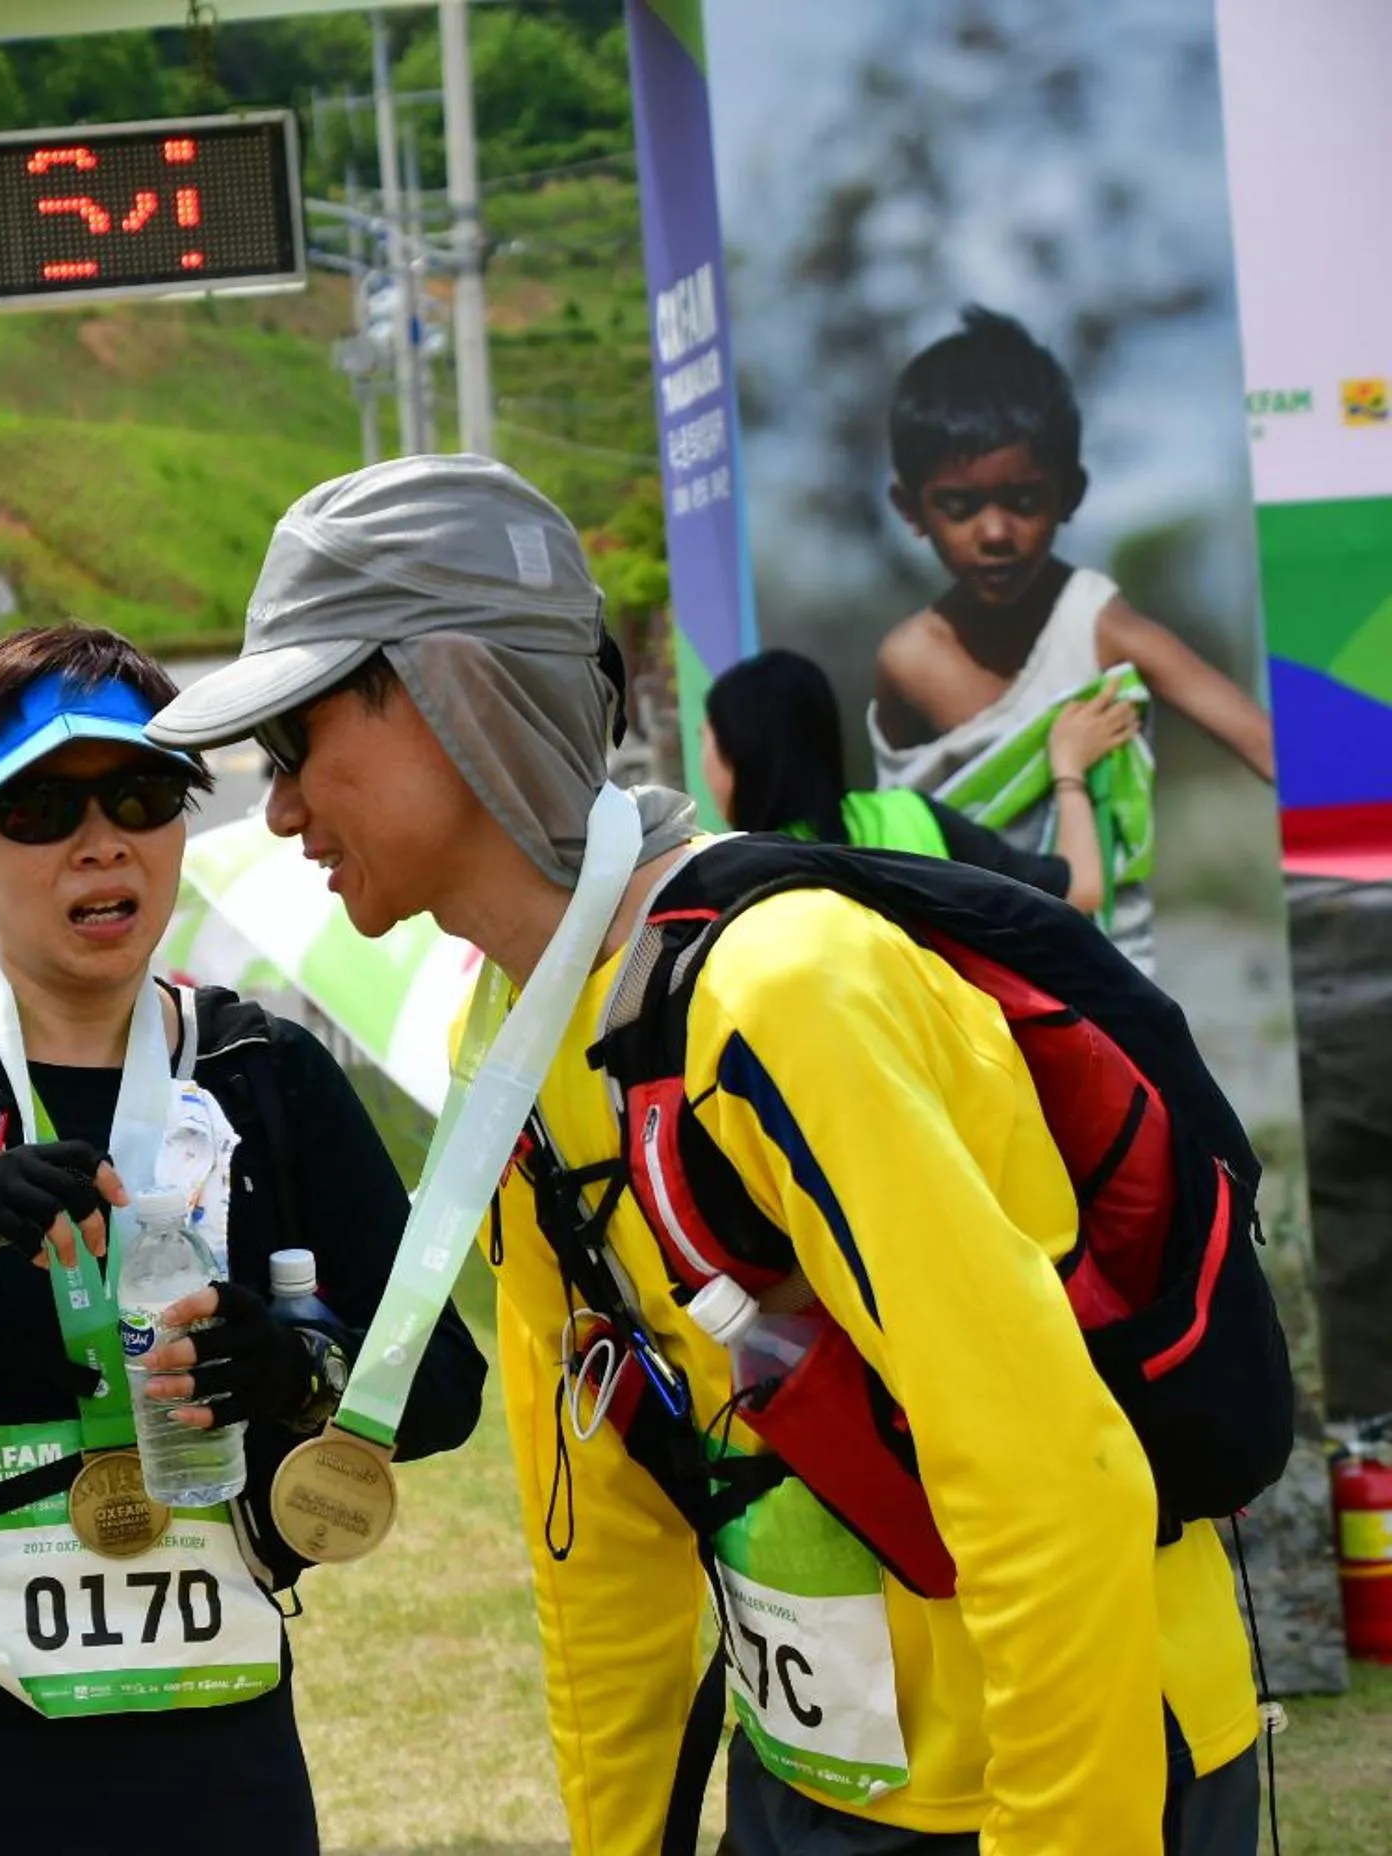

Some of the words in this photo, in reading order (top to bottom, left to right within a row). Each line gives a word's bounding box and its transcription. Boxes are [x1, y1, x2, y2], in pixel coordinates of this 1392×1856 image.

[23, 1541, 51, 1554] 2017
[56, 1540, 88, 1552] OXFA
[23, 1569, 222, 1652] 017D
[725, 1622, 823, 1728] 7C
